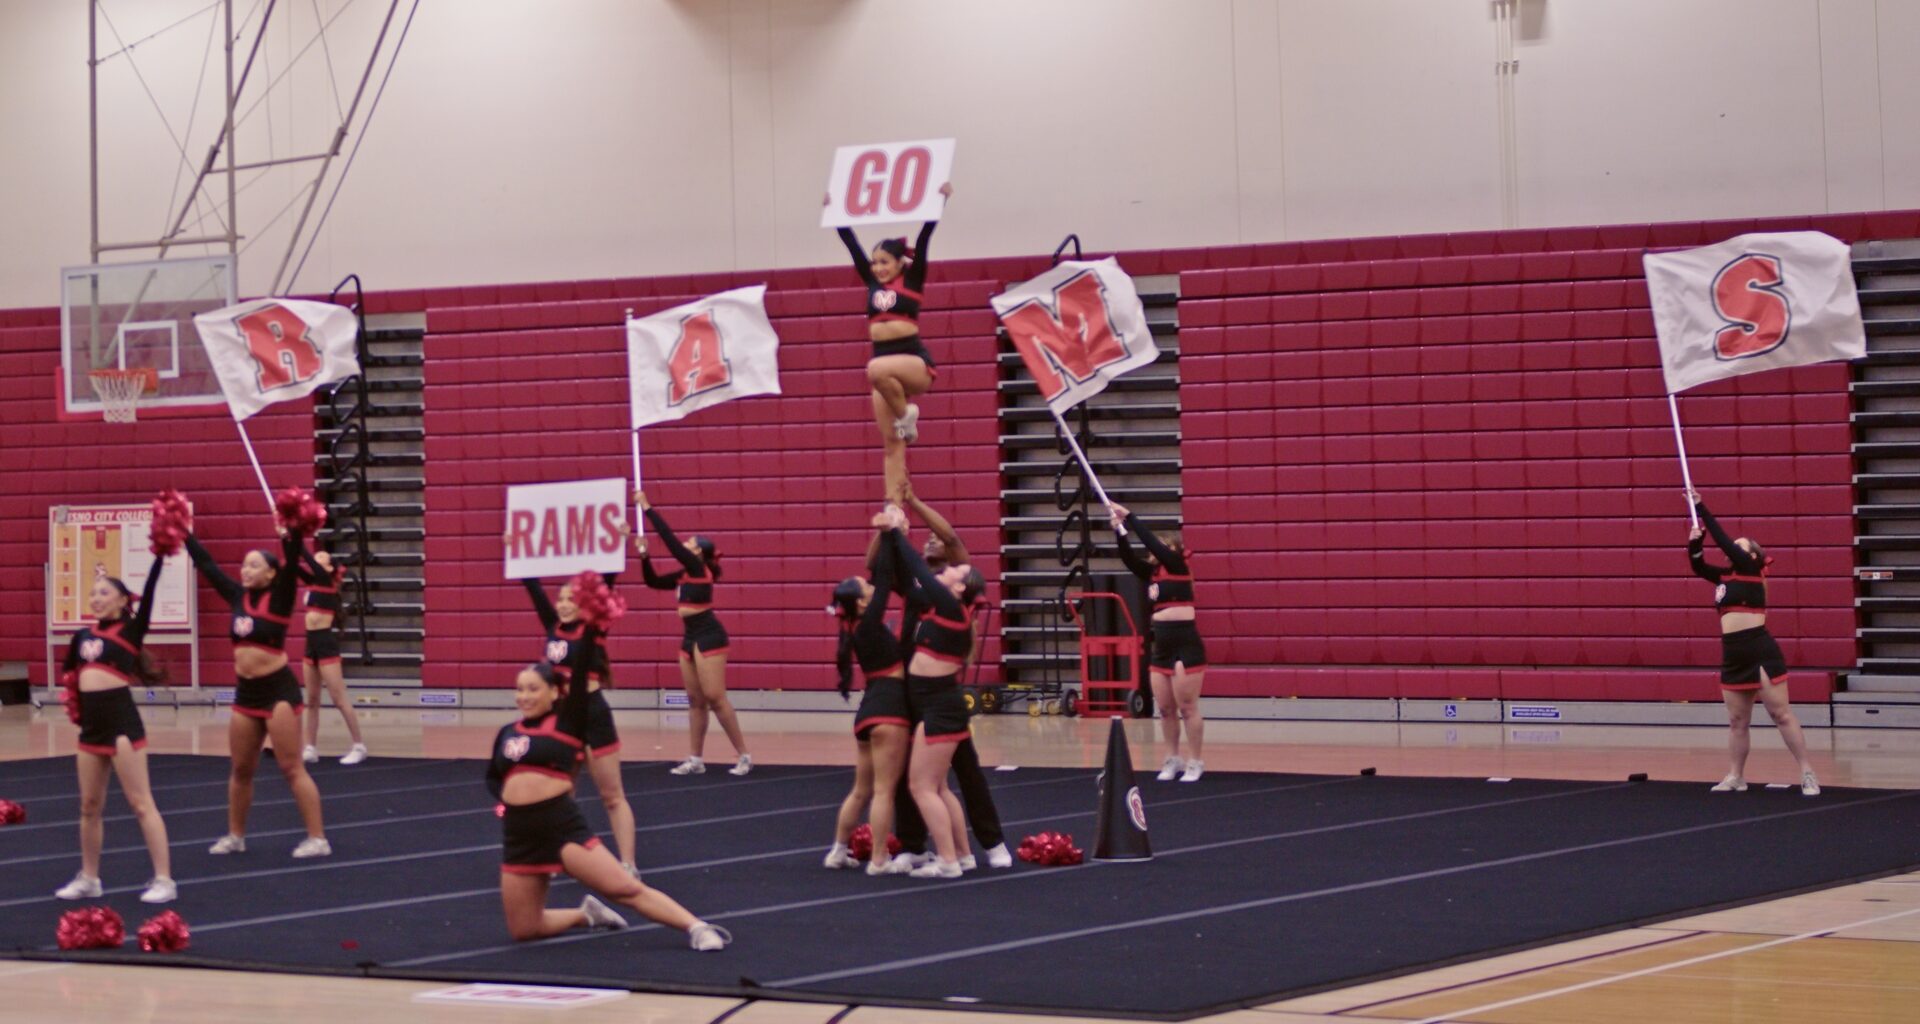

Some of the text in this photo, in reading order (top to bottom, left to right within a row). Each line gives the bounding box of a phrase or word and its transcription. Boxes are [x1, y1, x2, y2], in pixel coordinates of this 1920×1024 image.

[844, 147, 931, 217] GO
[231, 304, 323, 393] R
[1000, 268, 1130, 401] M
[1710, 253, 1790, 360] S
[667, 309, 731, 406] A
[68, 509, 154, 523] ESNO CITY COLLEG
[509, 503, 621, 559] RAMS
